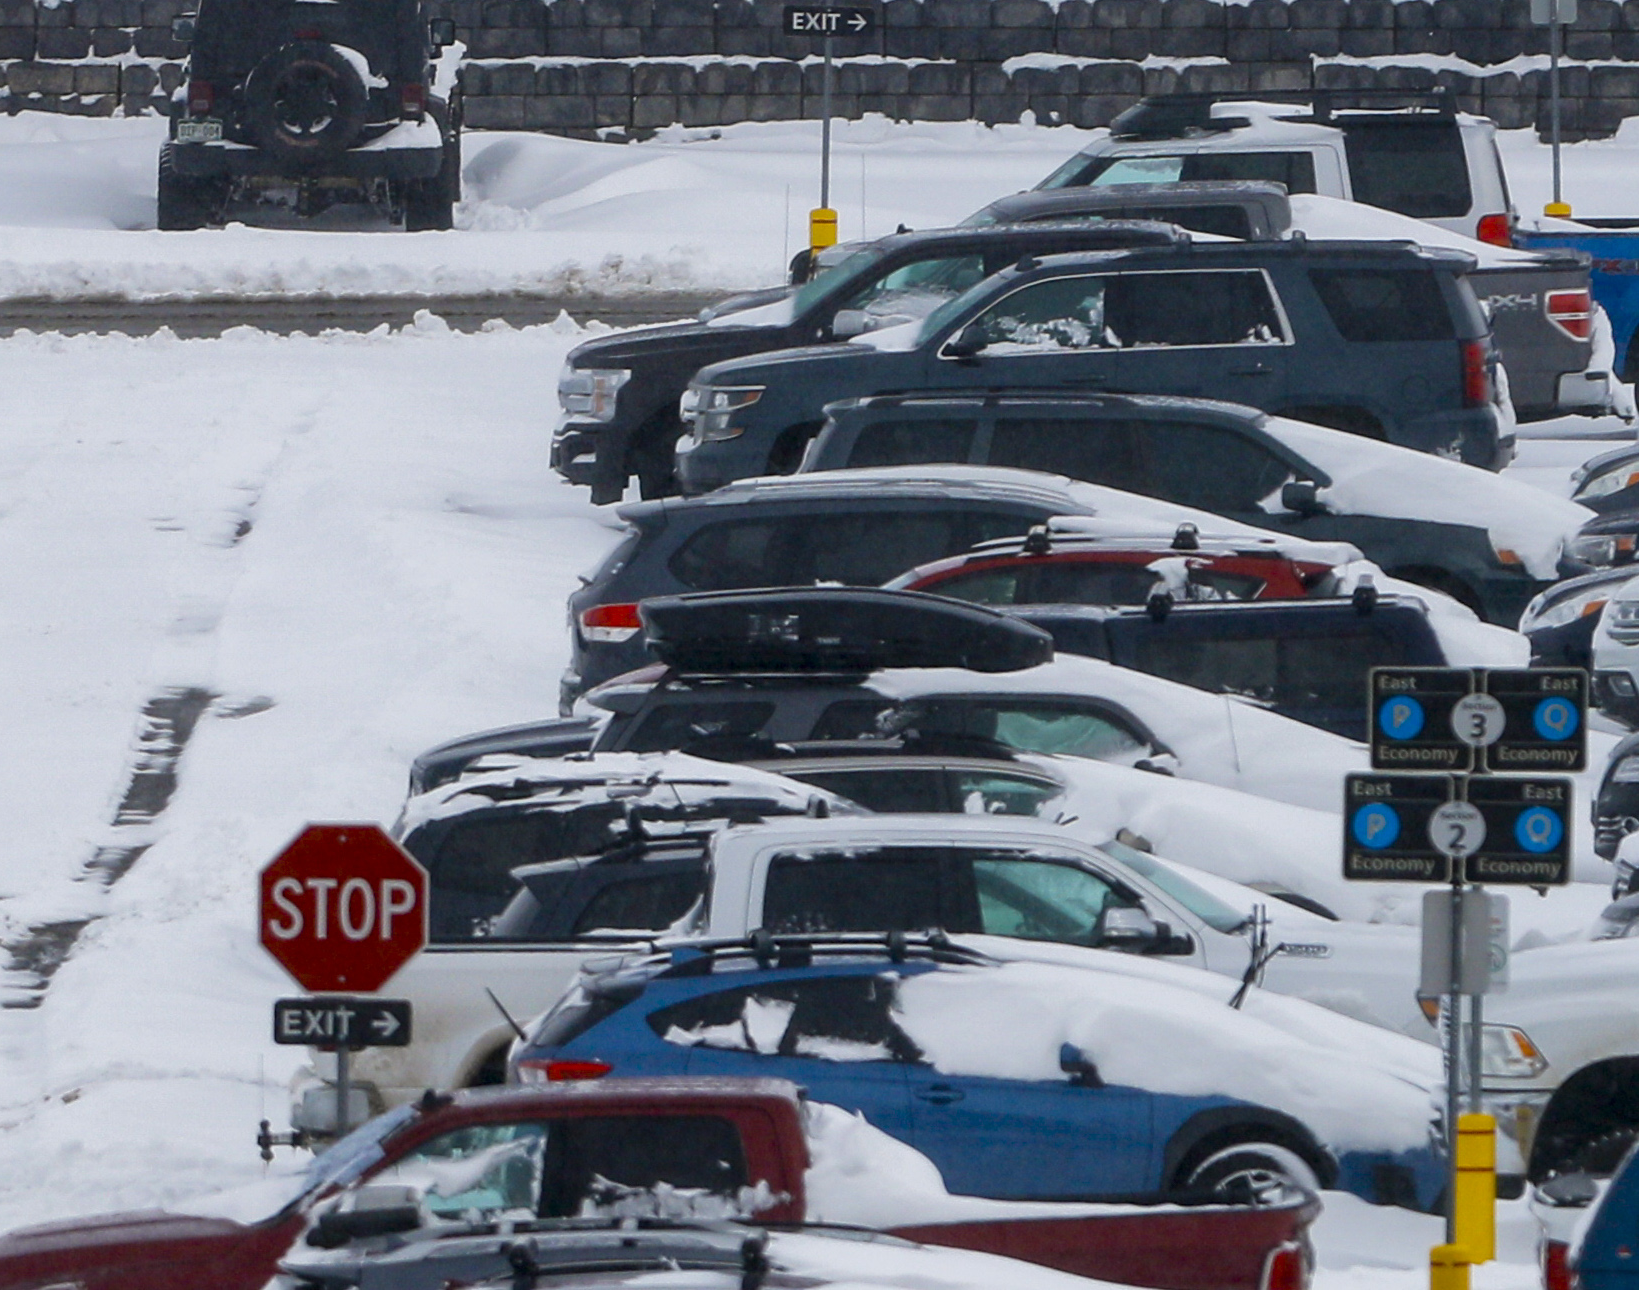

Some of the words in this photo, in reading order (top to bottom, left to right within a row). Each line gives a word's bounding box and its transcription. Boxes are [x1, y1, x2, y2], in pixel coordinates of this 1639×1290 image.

[791, 10, 840, 32] EXIT
[1378, 675, 1416, 690] East
[1541, 676, 1578, 690] East
[1393, 704, 1411, 728] P
[1471, 713, 1487, 738] 3
[1544, 704, 1568, 732] Q
[1380, 747, 1458, 764] Economy
[1500, 747, 1578, 764] Economy
[1353, 781, 1392, 796] East
[1524, 784, 1563, 799] East
[1367, 813, 1386, 840] P
[1449, 823, 1466, 850] 2
[1526, 813, 1552, 845] Q
[1352, 856, 1435, 874] Economy
[1479, 860, 1562, 879] Economy
[268, 877, 416, 940] STOP
[282, 1008, 355, 1038] EXIT
